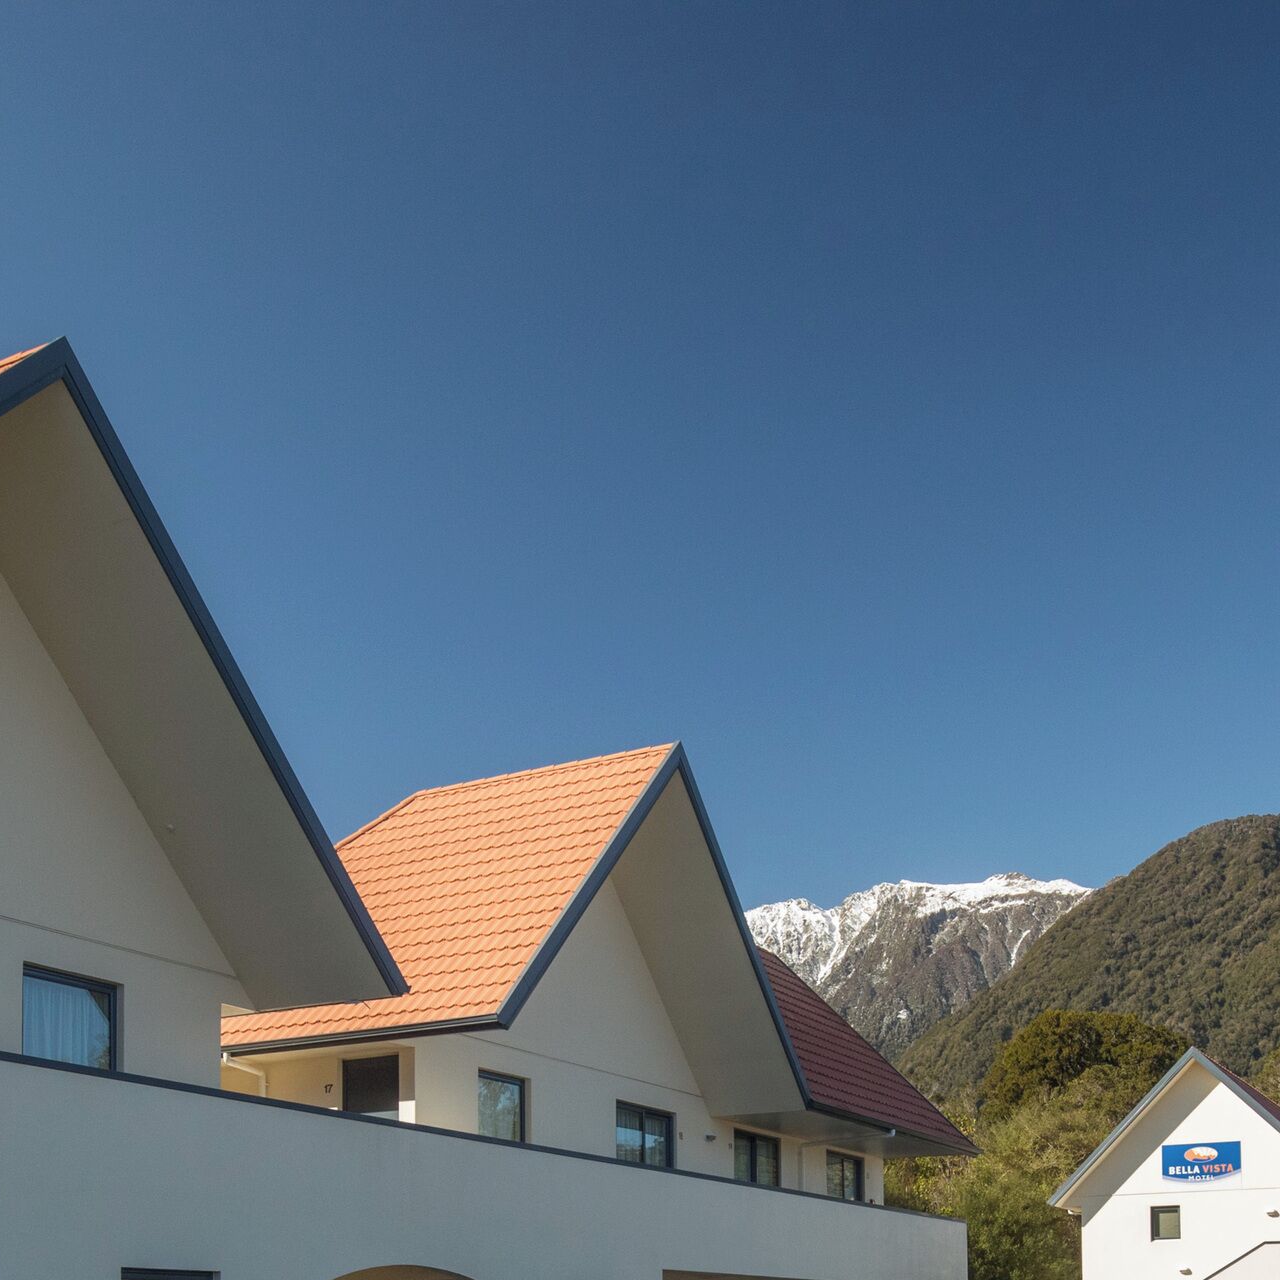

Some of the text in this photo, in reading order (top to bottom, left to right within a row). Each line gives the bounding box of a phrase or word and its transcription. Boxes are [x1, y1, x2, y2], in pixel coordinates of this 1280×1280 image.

[324, 1083, 334, 1094] 17
[1168, 1163, 1234, 1175] BELLA VISTA
